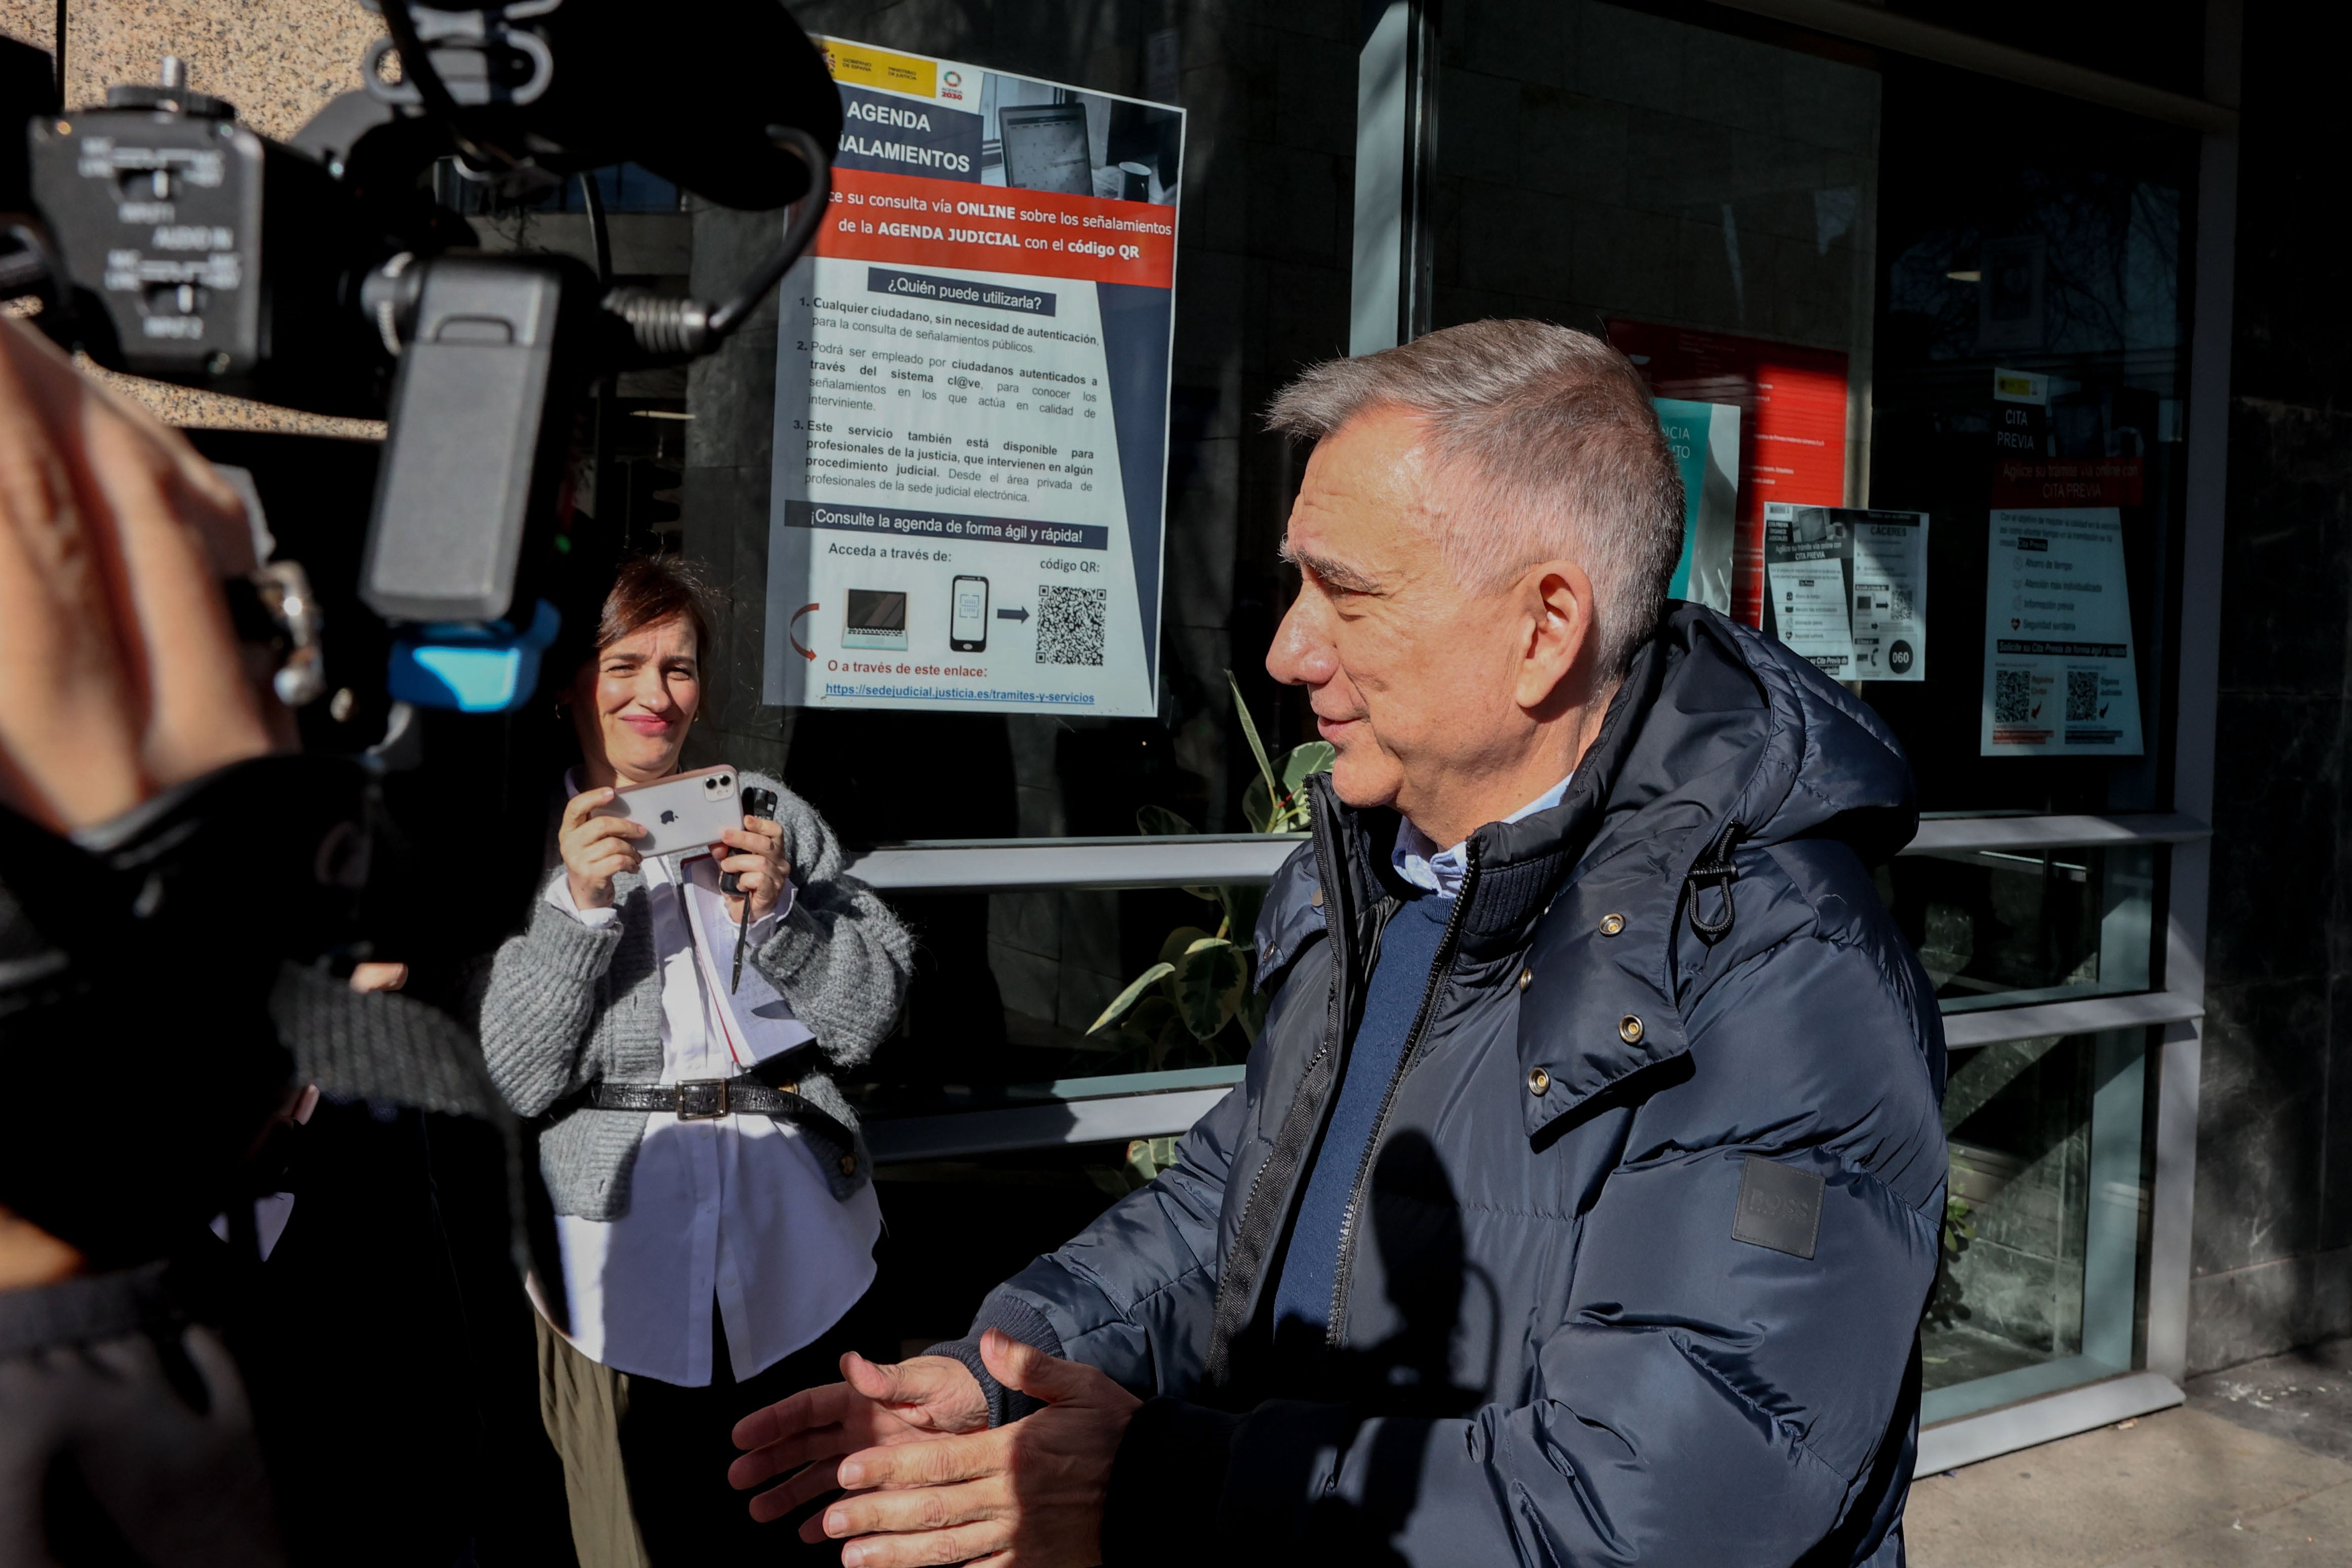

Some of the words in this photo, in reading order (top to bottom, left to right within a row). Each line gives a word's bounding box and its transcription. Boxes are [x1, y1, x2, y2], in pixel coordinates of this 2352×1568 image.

[843, 59, 871, 67] GOBIERNO
[851, 64, 871, 72] ESPAÑA
[888, 67, 916, 75] MINISTERIO
[942, 91, 962, 100] 2030
[847, 101, 931, 131] AGENDA
[848, 193, 863, 204] su
[869, 195, 927, 211] consulta
[932, 199, 952, 213] vía
[957, 202, 1015, 220] ONLINE
[1020, 209, 1056, 224] sobre
[1061, 212, 1079, 225] los
[1083, 215, 1172, 235] señalamientos
[839, 218, 856, 233] de
[861, 220, 873, 233] la
[878, 222, 944, 240] AGENDA
[948, 228, 1020, 247] JUDICIAL
[1025, 237, 1048, 249] con
[1053, 239, 1063, 251] el
[1068, 240, 1115, 257] código
[1119, 244, 1139, 260] QR
[888, 277, 935, 295] ¿Quién
[939, 287, 979, 301] puede
[983, 292, 1041, 310] utilizarla?
[799, 297, 809, 306] 1.
[814, 297, 868, 313] Cualquier
[871, 306, 932, 324] ciudadano,
[935, 315, 951, 325] sin
[955, 318, 1009, 333] necesidad
[1012, 325, 1024, 334] de
[1027, 328, 1099, 346] autenticación,
[812, 317, 836, 328] para
[840, 318, 849, 329] la
[853, 322, 896, 335] consulta
[900, 328, 912, 337] de
[916, 331, 989, 347] señalamientos
[992, 339, 1035, 353] públicos.
[797, 341, 807, 350] 2.
[811, 341, 843, 354] Podrá
[850, 348, 866, 357] ser
[872, 351, 923, 365] empleado
[929, 357, 946, 368] por
[952, 359, 1013, 376] ciudadanos
[1020, 369, 1085, 385] autenticados
[810, 360, 845, 372] través
[860, 366, 876, 376] del
[891, 370, 933, 383] sistema
[948, 376, 983, 390] cl@ve,
[997, 383, 1019, 393] para
[1032, 387, 1070, 399] conocer
[1083, 392, 1096, 402] los
[809, 378, 886, 394] señalamientos
[898, 388, 910, 397] en
[922, 389, 936, 400] los
[949, 394, 967, 404] que
[979, 397, 1005, 408] actúa
[1017, 402, 1028, 410] en
[1039, 404, 1073, 415] calidad
[1084, 408, 1095, 418] de
[809, 394, 875, 411] interviniente.
[2005, 409, 2027, 426] CITA
[793, 420, 803, 429] 3.
[808, 421, 832, 432] Este
[848, 426, 893, 439] servicio
[908, 432, 951, 444] también
[966, 438, 988, 448] está
[1003, 441, 1057, 455] disponible
[1071, 449, 1094, 459] para
[1997, 431, 2034, 450] PREVIA
[807, 440, 883, 455] profesionales
[888, 447, 901, 456] de
[905, 448, 914, 457] la
[917, 449, 960, 463] justicia,
[964, 455, 983, 465] que
[987, 455, 1045, 471] intervienen
[1049, 463, 1061, 472] en
[1065, 464, 1092, 476] algún
[806, 457, 887, 473] procedimiento
[897, 464, 939, 477] judicial.
[949, 468, 981, 481] Desde
[990, 474, 998, 483] el
[1007, 475, 1028, 486] área
[1037, 479, 1072, 490] privada
[1081, 482, 1092, 491] de
[805, 475, 875, 489] profesionales
[879, 480, 892, 490] de
[896, 481, 904, 491] la
[908, 483, 932, 493] sede
[935, 485, 970, 497] judicial
[974, 488, 1030, 502] electrónica.
[2043, 483, 2064, 498] CITA
[2066, 483, 2101, 498] PREVIA
[811, 508, 874, 527] ¡Consulte
[879, 514, 890, 528] la
[894, 518, 942, 532] agenda
[946, 519, 962, 533] de
[966, 521, 1002, 536] forma
[1006, 525, 1027, 541] ágil
[1030, 529, 1038, 542] y
[1041, 528, 1082, 543] rápida!
[829, 543, 876, 557] Acceda
[880, 549, 886, 558] a
[891, 550, 928, 560] través
[933, 552, 952, 562] de:
[1040, 559, 1076, 573] código
[1080, 561, 1100, 572] QR:
[828, 660, 838, 671] O
[842, 664, 849, 672] a
[853, 661, 892, 674] través
[896, 663, 910, 674] de
[915, 665, 940, 675] este
[944, 665, 987, 677] enlace:
[1893, 651, 1909, 663] 060
[826, 684, 1094, 704] https://sedejudicial.justicia.es/tramites-y-servicios
[1750, 1187, 1809, 1217] BOSS
